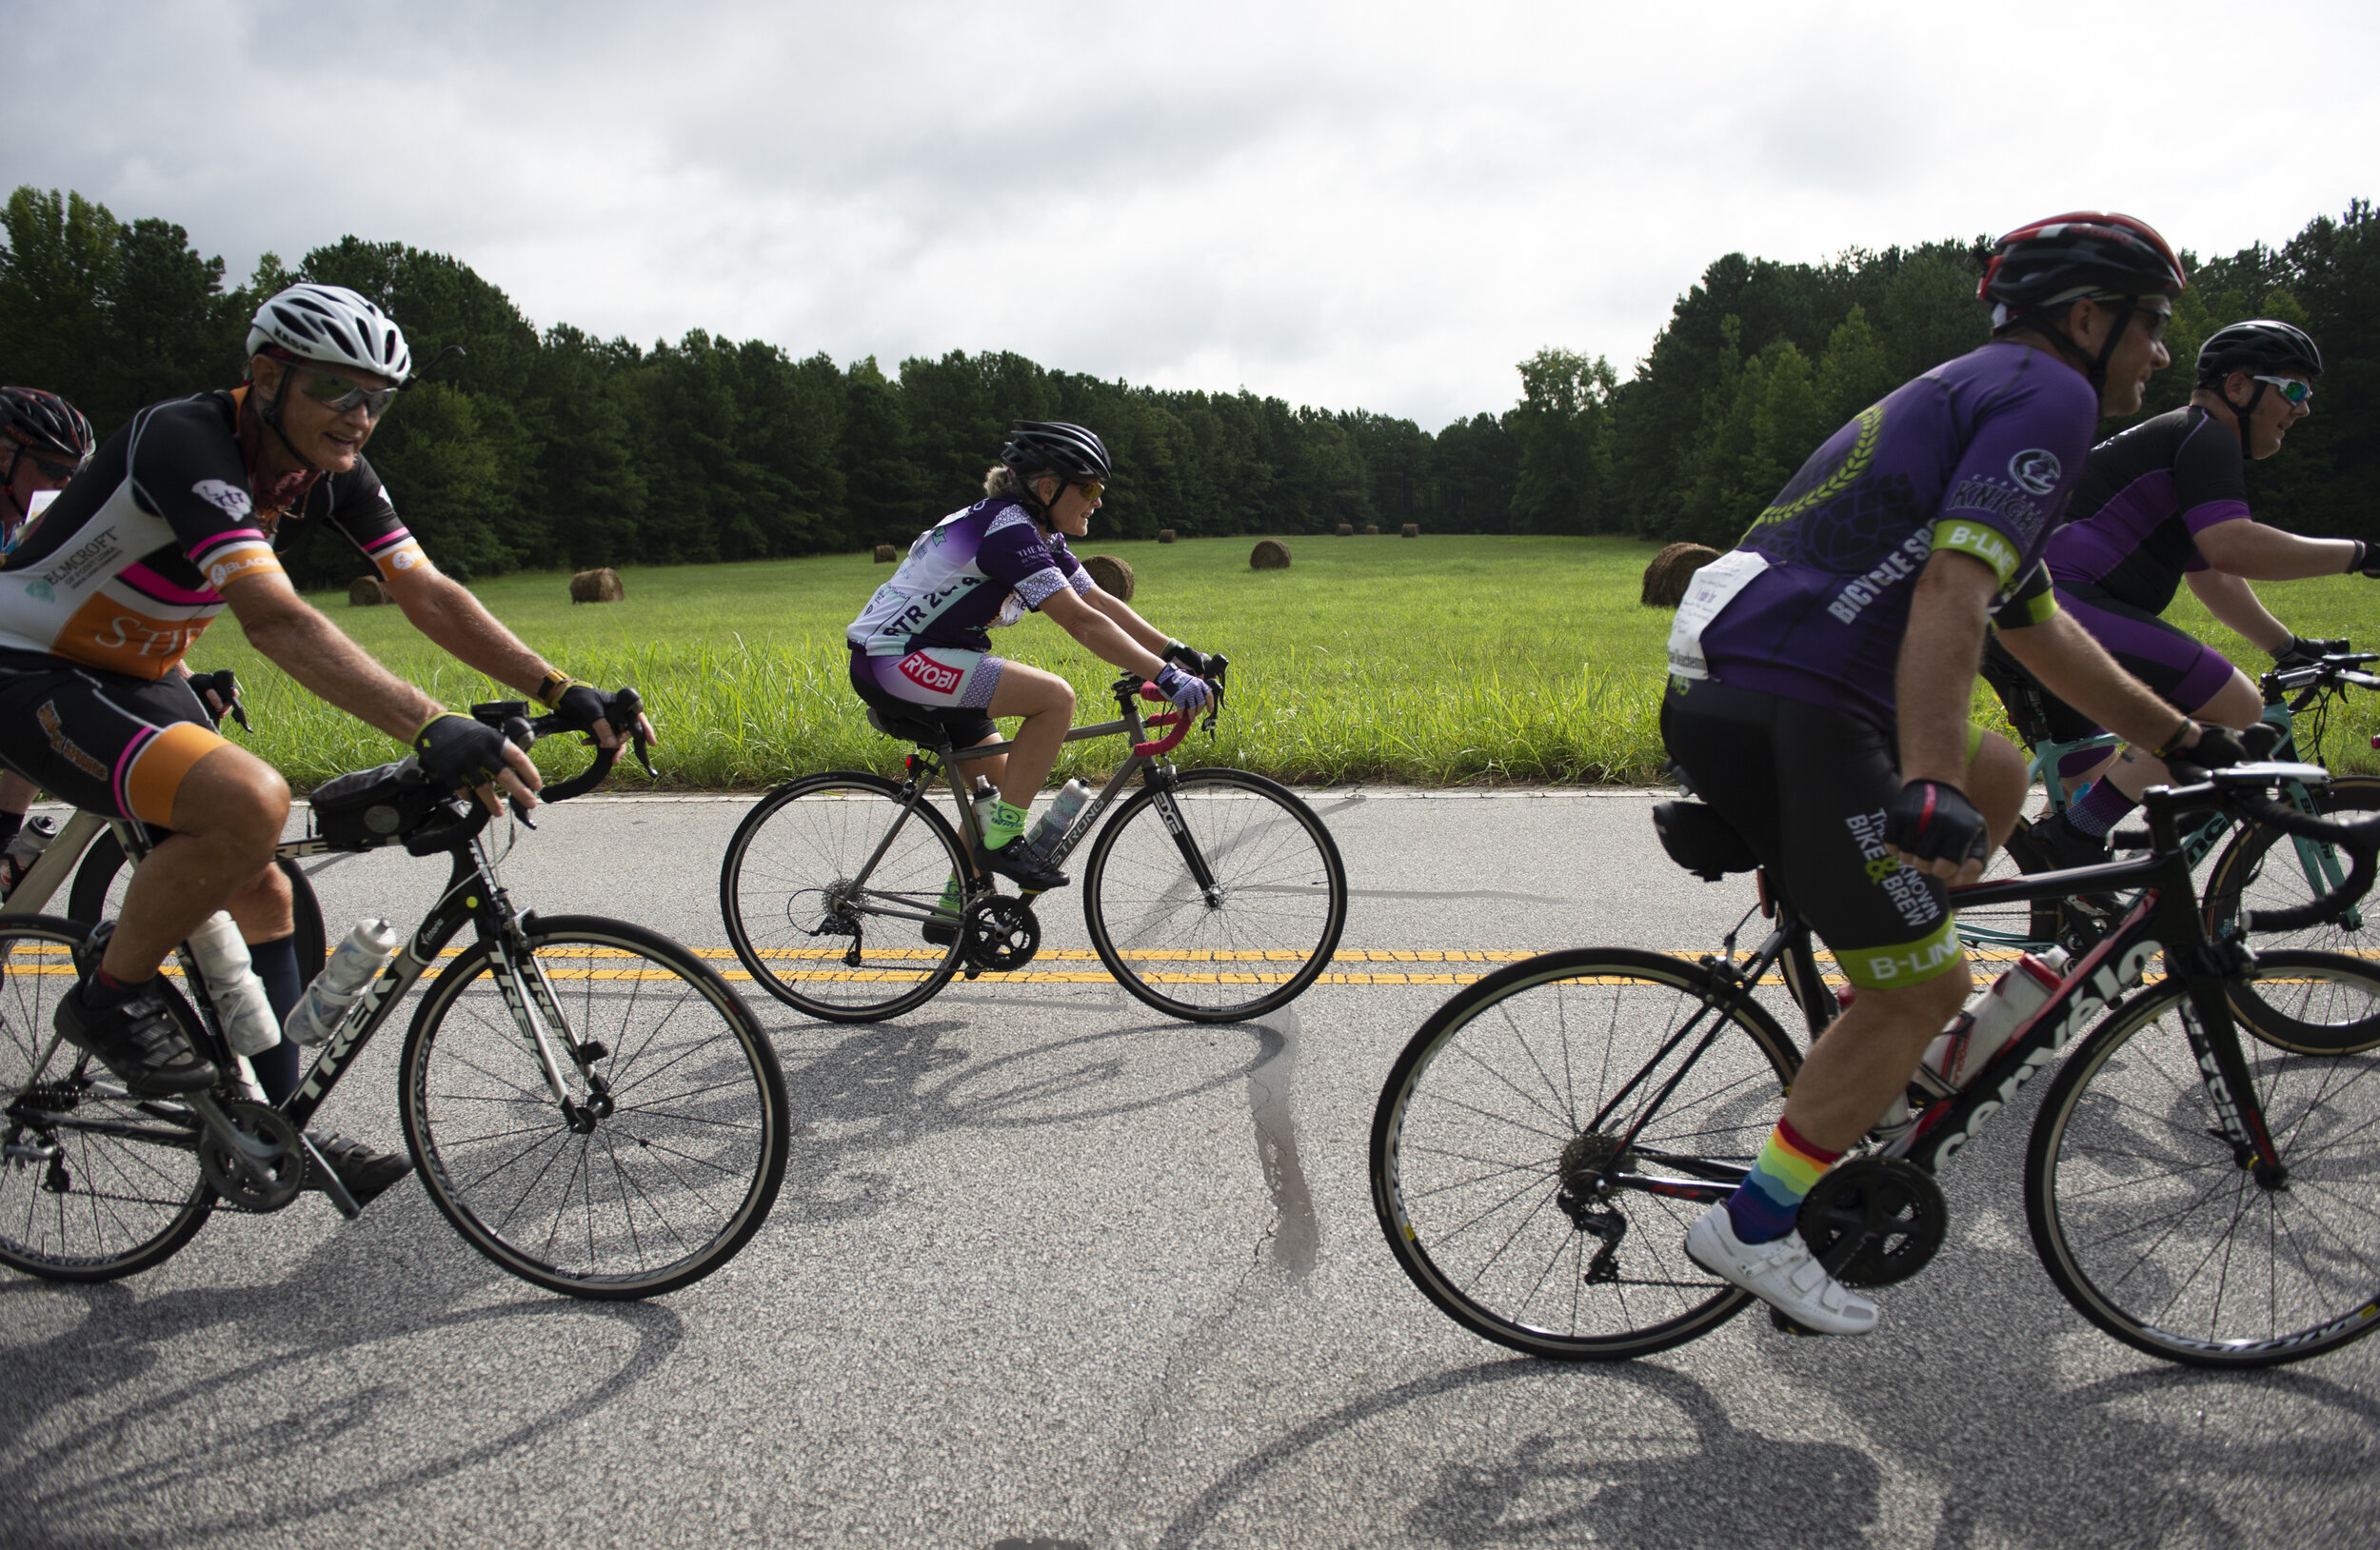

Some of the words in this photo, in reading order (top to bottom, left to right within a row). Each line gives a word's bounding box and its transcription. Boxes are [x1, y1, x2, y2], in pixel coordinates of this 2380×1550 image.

[43, 527, 118, 586] ELMCROFT
[1827, 550, 1916, 625] BICYCLE
[883, 606, 928, 637] RTR
[903, 653, 958, 690] RYOBI
[1050, 797, 1104, 865] STRONG
[1845, 813, 1887, 861] BIKE
[1865, 856, 1899, 885] &
[1881, 875, 1928, 927] BREW
[1870, 924, 1959, 981] B-LIN
[294, 969, 400, 1101] TREK
[489, 941, 553, 1085] TREK
